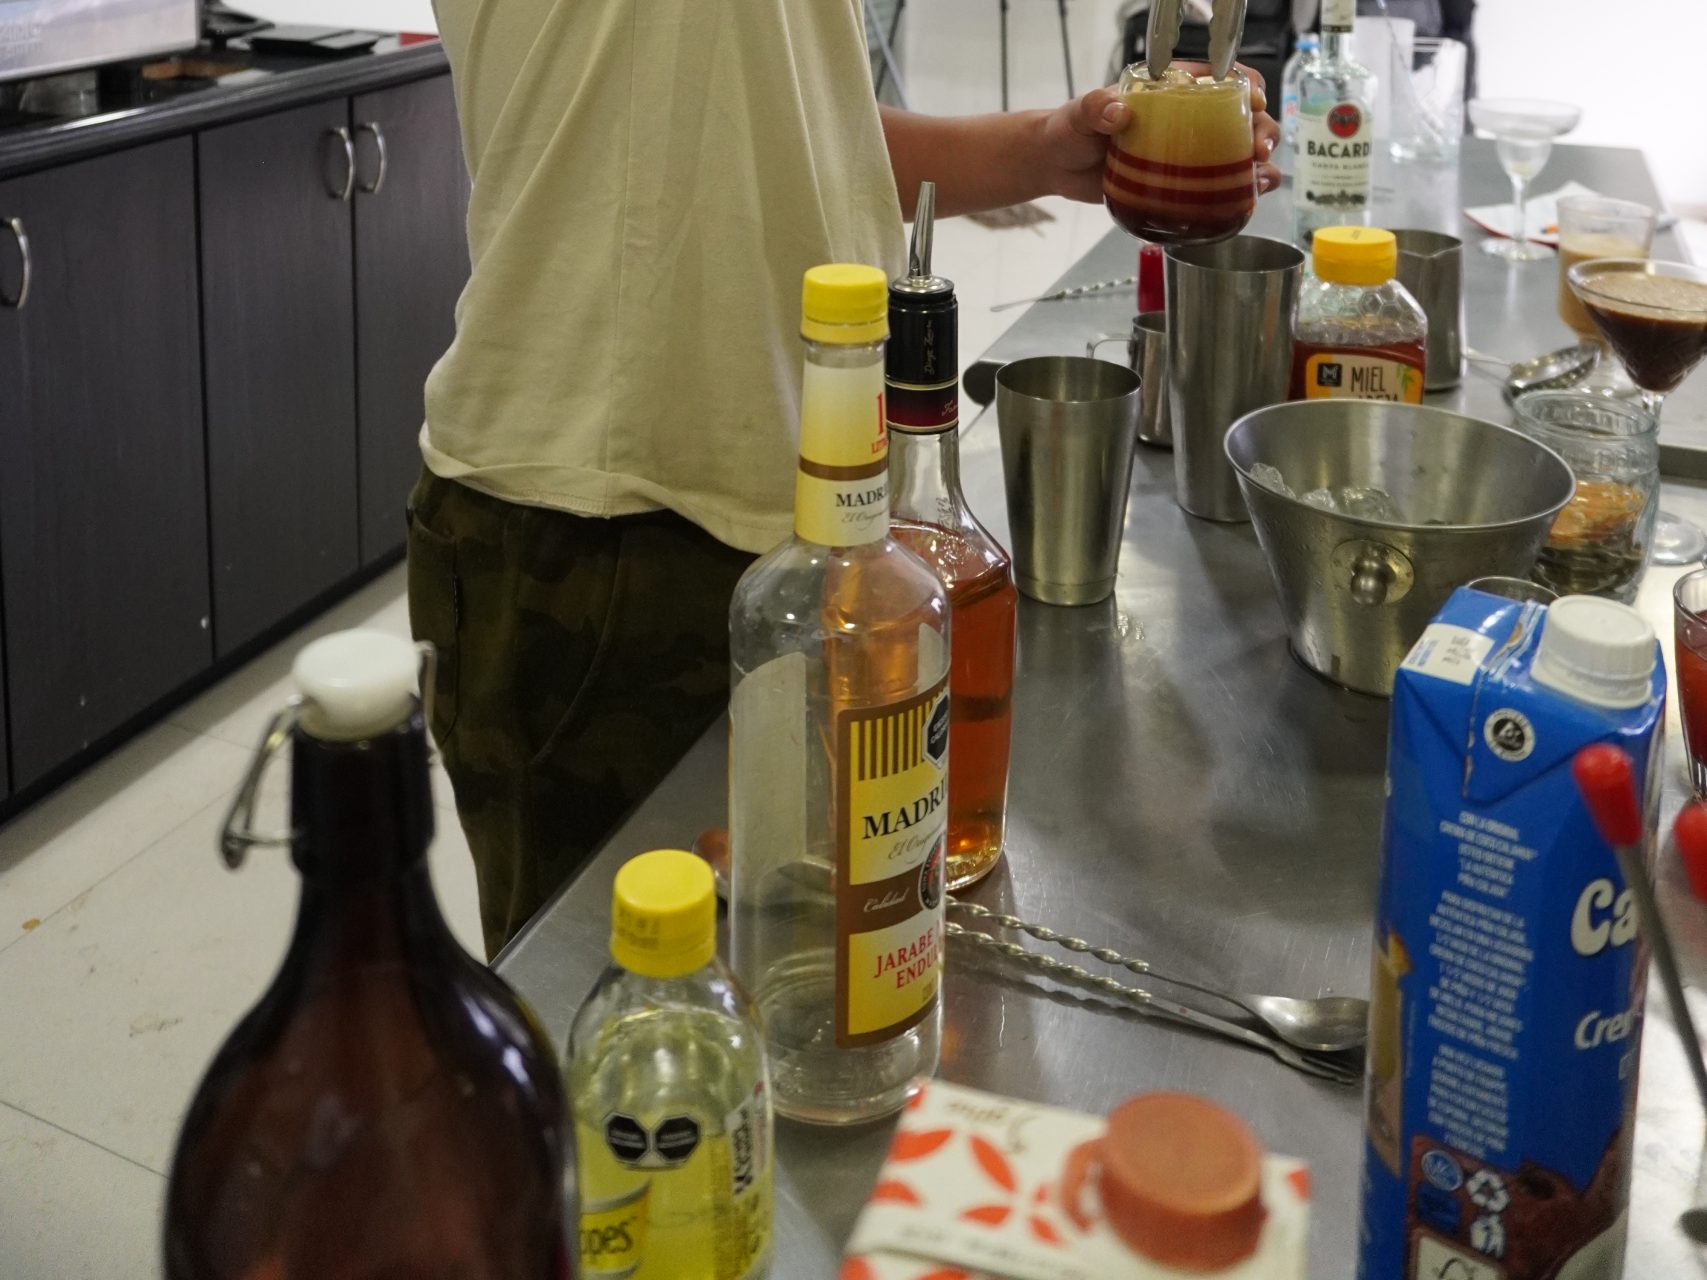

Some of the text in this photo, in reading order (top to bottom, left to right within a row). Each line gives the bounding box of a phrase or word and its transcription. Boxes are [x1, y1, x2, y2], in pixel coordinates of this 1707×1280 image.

[1351, 366, 1386, 393] MIEL
[876, 392, 885, 437] 1
[863, 775, 946, 840] MADRI
[1571, 878, 1638, 956] Ca
[873, 928, 933, 979] JARABE
[1574, 1010, 1633, 1051] Cre
